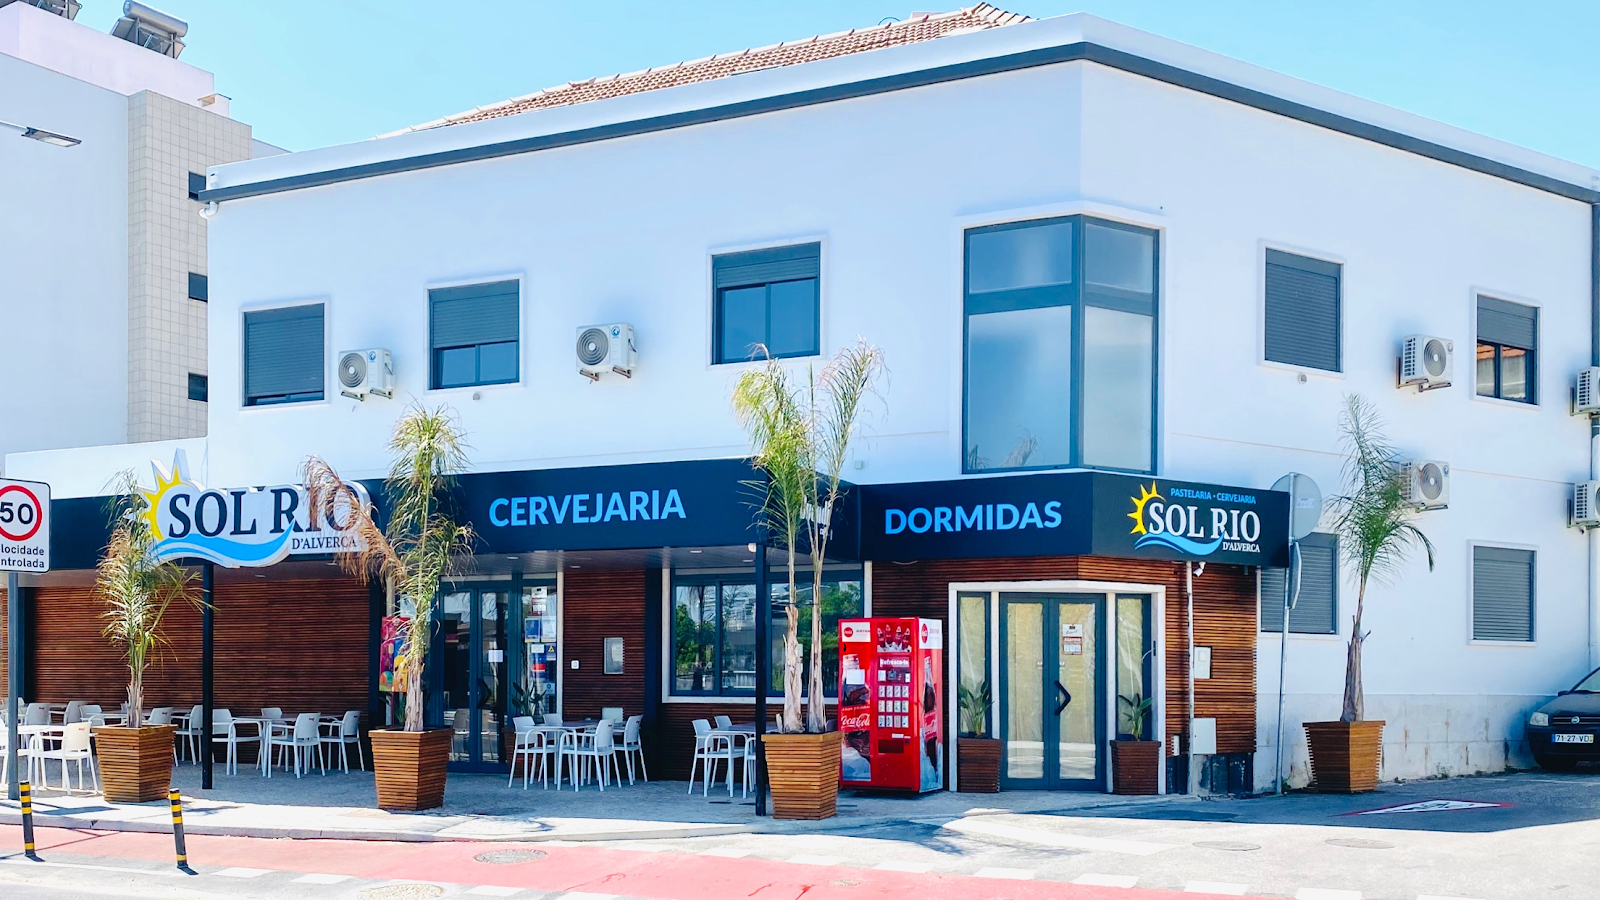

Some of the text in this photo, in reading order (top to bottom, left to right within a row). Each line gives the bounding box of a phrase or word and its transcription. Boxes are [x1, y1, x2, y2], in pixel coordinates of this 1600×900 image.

[1170, 487, 1257, 504] PASTELARIA CERVEJARIA
[0, 501, 34, 525] 50
[168, 484, 361, 539] SOL RIO
[489, 489, 687, 527] CERVEJARIA
[885, 500, 1062, 534] DORMIDAS
[1148, 502, 1261, 542] SOL RIO
[0, 543, 45, 556] locidade
[291, 536, 358, 550] D'ALVERCA
[1222, 541, 1261, 553] D'ALVERCA
[0, 557, 45, 568] ntrolada
